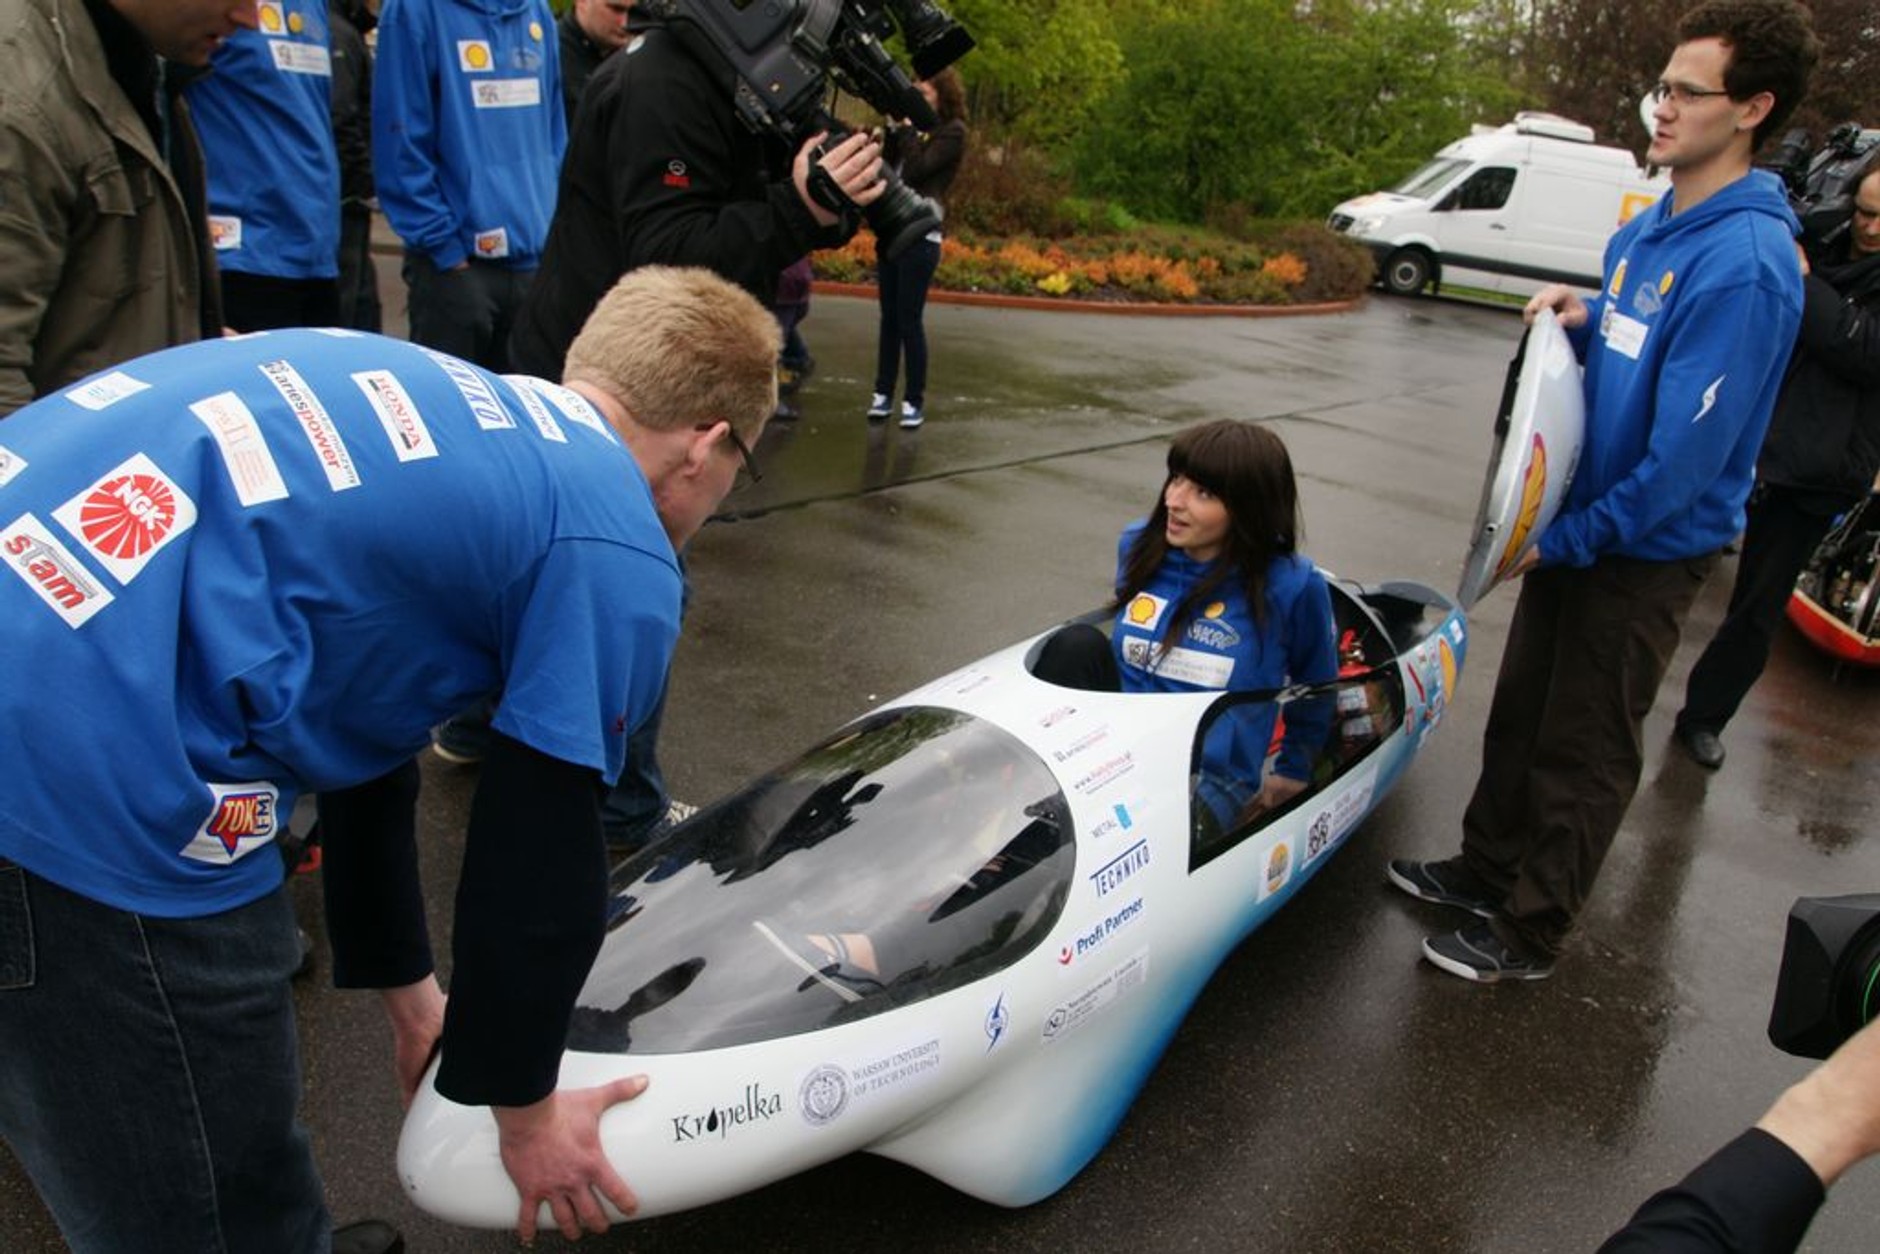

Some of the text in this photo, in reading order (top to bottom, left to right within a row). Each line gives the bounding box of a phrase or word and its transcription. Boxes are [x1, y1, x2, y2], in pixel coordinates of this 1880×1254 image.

[376, 376, 423, 448] HONDA
[113, 481, 167, 531] NGK
[217, 799, 257, 833] TOK
[254, 798, 270, 829] FM
[1091, 840, 1151, 897] TECHNIKO
[1075, 897, 1144, 955] Profi Partner
[851, 1038, 941, 1082] WARSAW UNIVERSITY
[853, 1079, 868, 1096] OF
[871, 1053, 941, 1090] TECHNOLOGY
